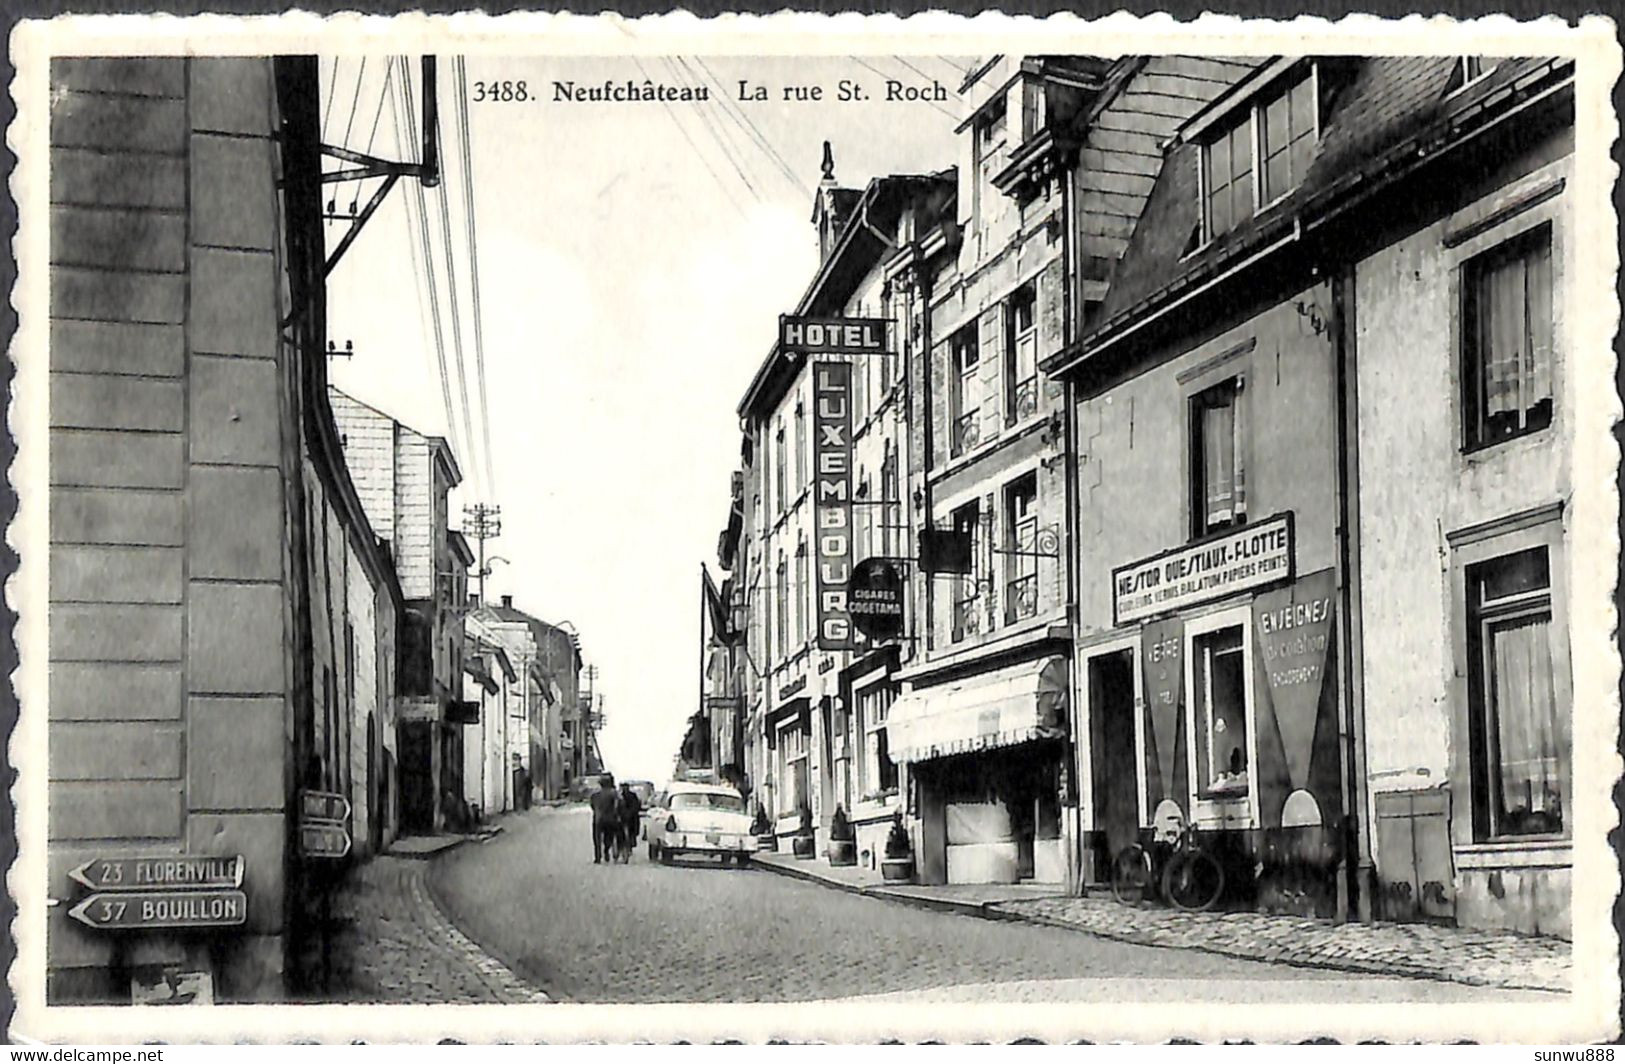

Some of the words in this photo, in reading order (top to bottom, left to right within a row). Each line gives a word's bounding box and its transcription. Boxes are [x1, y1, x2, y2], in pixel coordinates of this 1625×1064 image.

[786, 323, 880, 348] HOTEL
[818, 370, 849, 641] LUXEMBOURG
[1119, 567, 1160, 597] NESTOR
[854, 589, 896, 600] CIGARES
[848, 601, 901, 614] COGETAMA
[1261, 597, 1329, 634] ENSEIGNES
[101, 862, 123, 883] 23
[136, 860, 236, 882] FLORENVILLE
[100, 901, 127, 922] 37
[142, 899, 236, 921] BOUILLON
